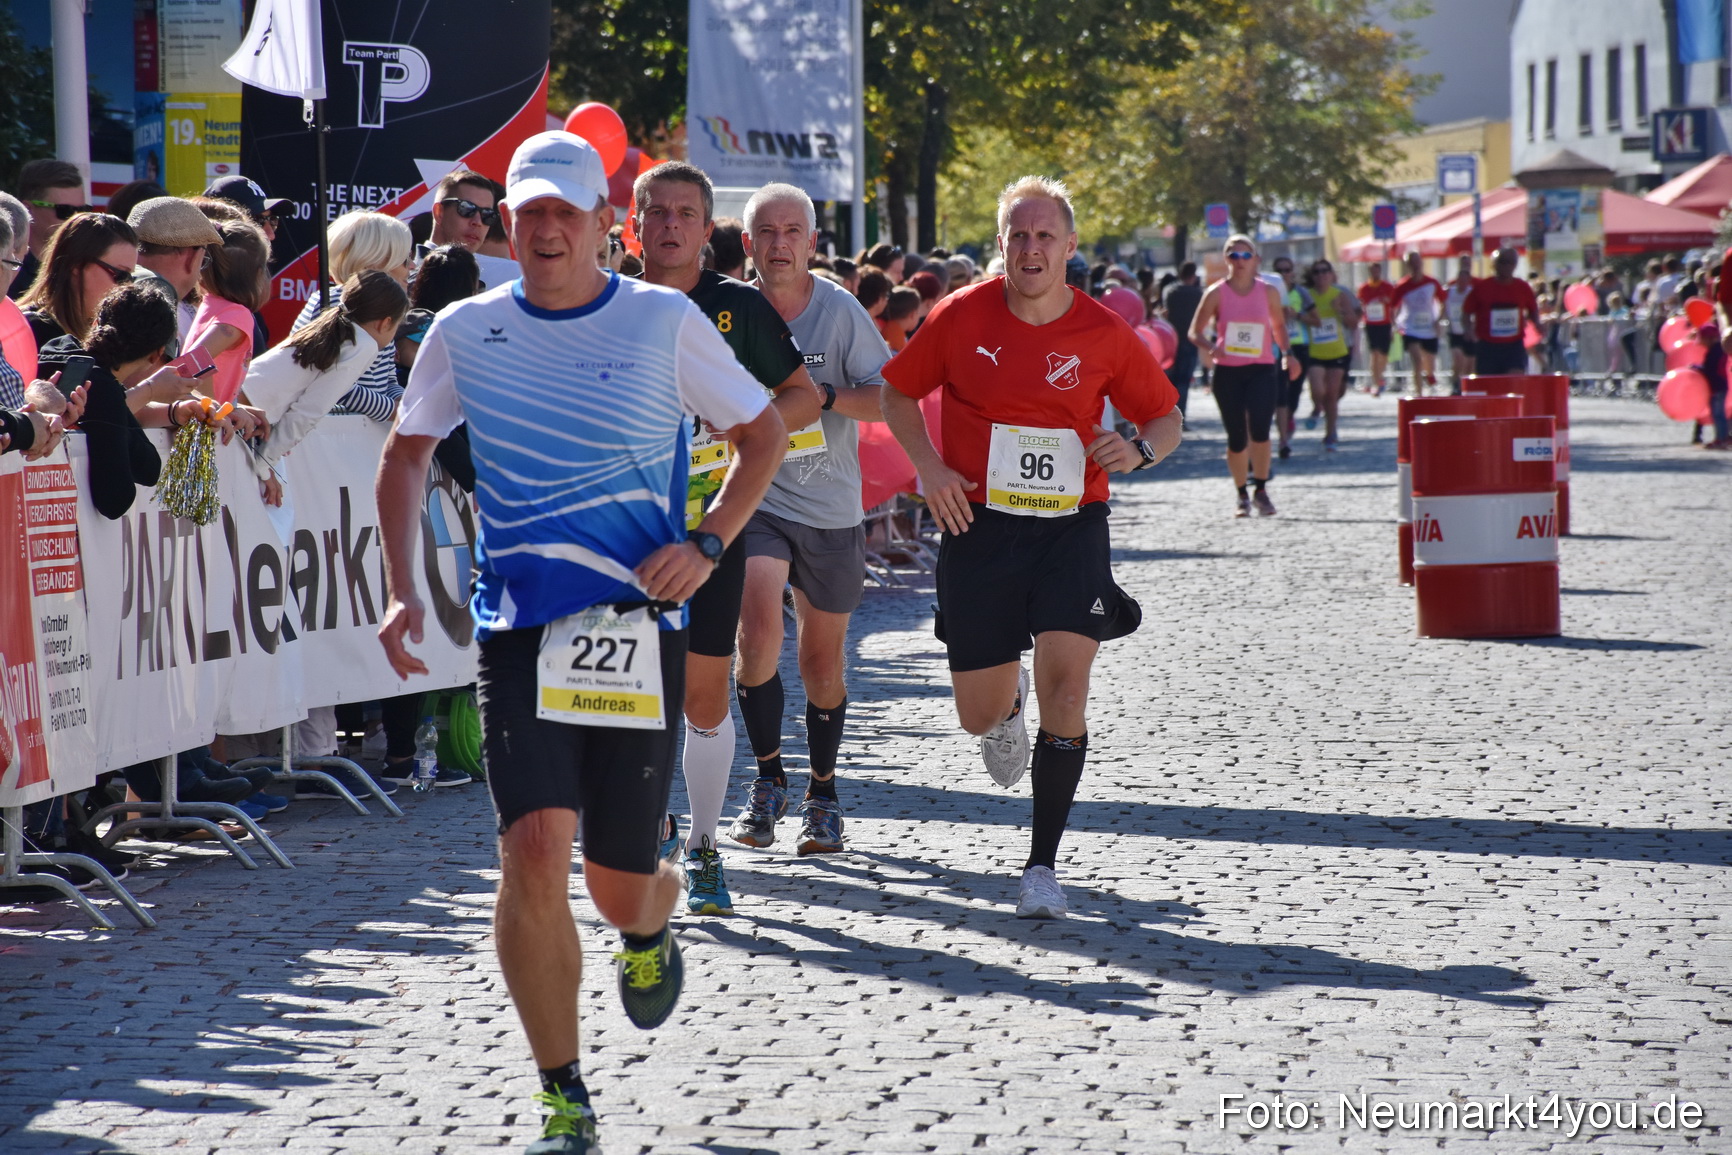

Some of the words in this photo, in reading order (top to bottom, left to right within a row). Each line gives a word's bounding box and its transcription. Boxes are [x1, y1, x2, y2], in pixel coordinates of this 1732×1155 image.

[349, 48, 375, 58] Team
[375, 48, 399, 60] Partl
[169, 118, 203, 146] 19.
[351, 184, 404, 206] NEXT
[286, 201, 312, 220] 00
[1237, 331, 1251, 343] 95
[1018, 434, 1061, 447] BOCK
[1020, 452, 1055, 481] 96
[1008, 494, 1060, 509] Christian
[570, 635, 638, 673] 227
[566, 677, 593, 685] PARTL
[595, 679, 634, 688] Neumarkt
[571, 693, 636, 713] Andreas
